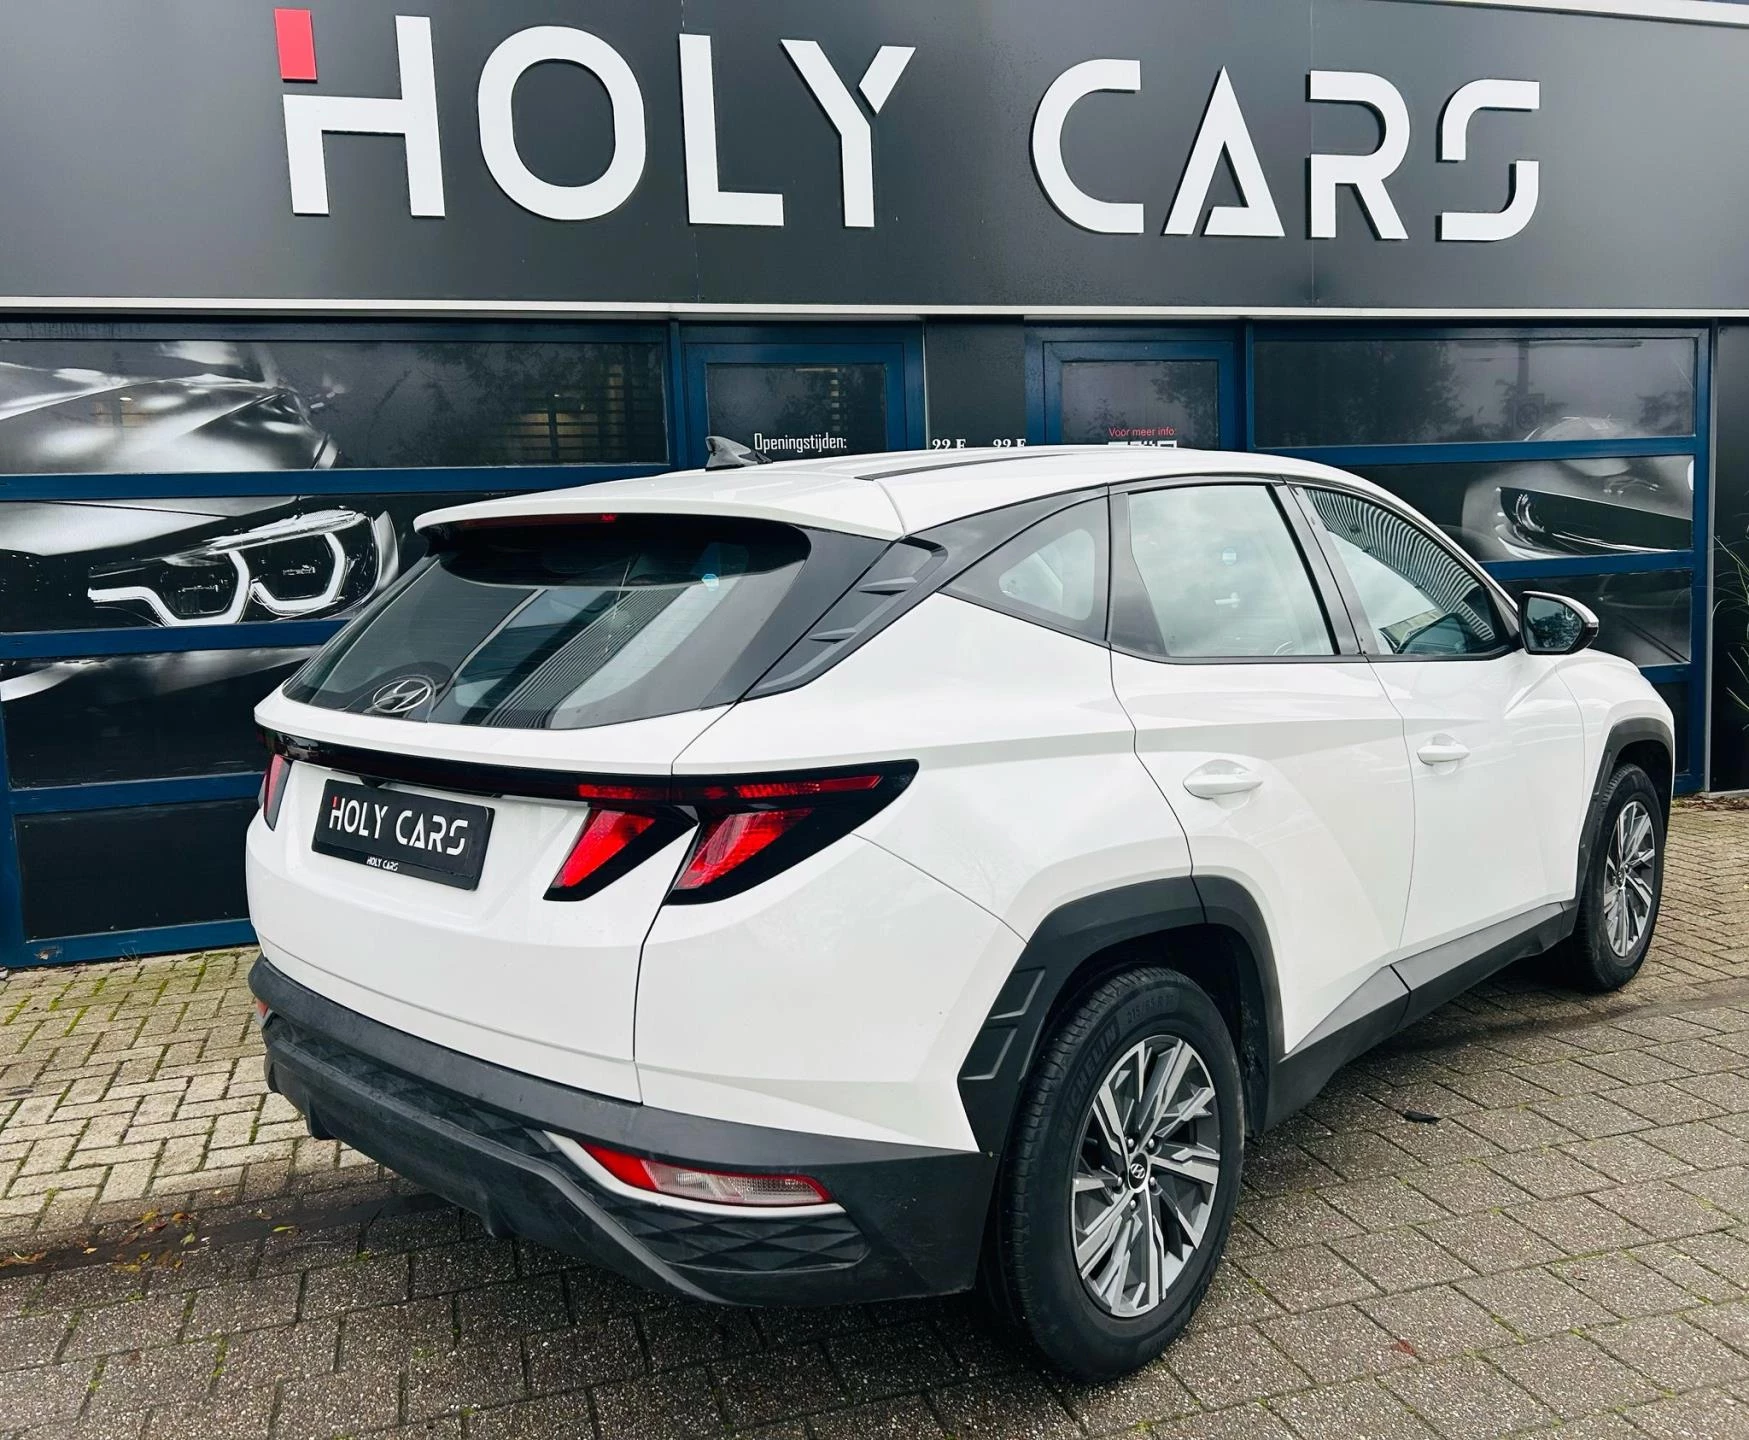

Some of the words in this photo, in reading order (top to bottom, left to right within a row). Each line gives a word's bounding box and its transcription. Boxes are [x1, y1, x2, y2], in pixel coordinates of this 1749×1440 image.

[274, 8, 917, 228] HOLY
[1031, 58, 1540, 241] CARS
[754, 431, 848, 454] Openingstijden:
[1108, 426, 1131, 438] Voor
[1132, 427, 1156, 437] meer
[328, 795, 389, 839] HOLY
[395, 810, 469, 856] CARS
[366, 856, 383, 868] HOLY
[1058, 1022, 1117, 1143] MICHELIN
